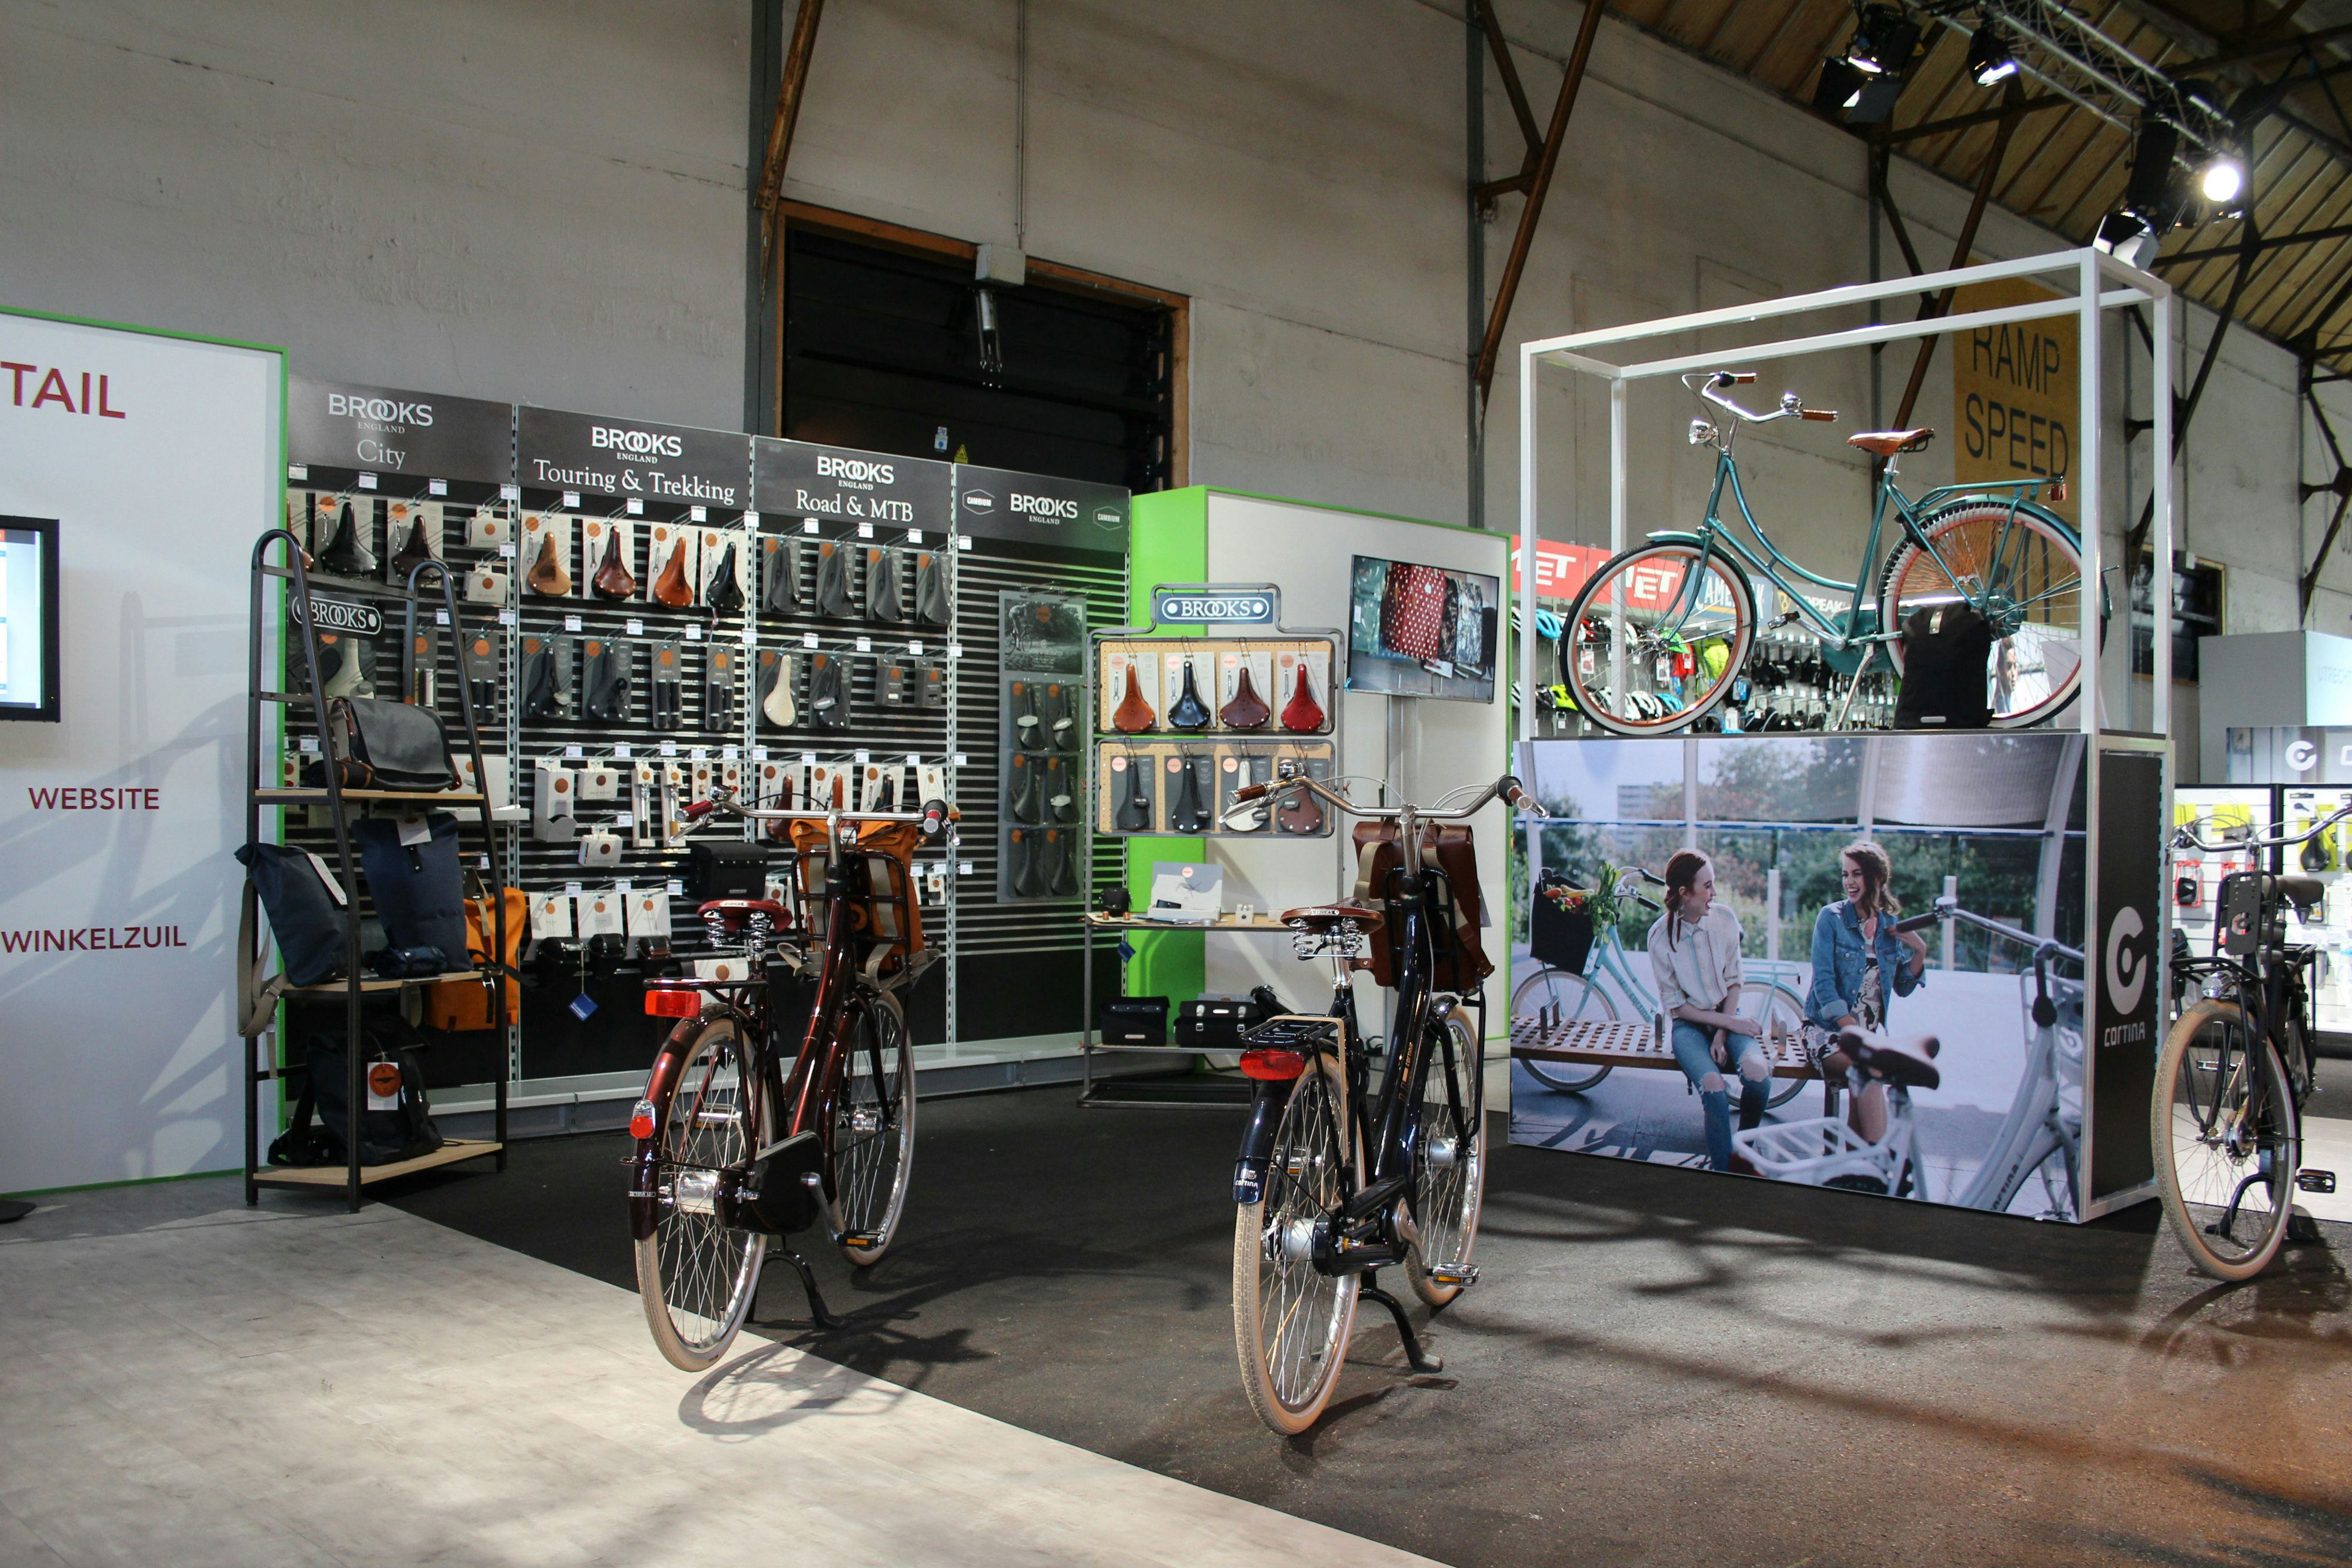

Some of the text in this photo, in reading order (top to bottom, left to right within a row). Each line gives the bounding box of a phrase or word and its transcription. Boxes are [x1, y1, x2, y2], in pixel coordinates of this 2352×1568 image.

[1973, 320, 2060, 396] RAMP
[0, 360, 126, 419] TAIL
[328, 393, 433, 427] BROOKS
[358, 422, 405, 434] ENGLAND
[591, 426, 683, 457] BROOKS
[1965, 392, 2069, 477] SPEED
[357, 439, 406, 470] City
[617, 452, 658, 464] ENGLAND
[533, 459, 735, 506] Touring & Trekking
[817, 456, 895, 485] BROOKS
[838, 480, 874, 491] ENGLAND
[796, 489, 914, 523] Road & MTB
[967, 496, 992, 507] CAMBIUM
[1010, 493, 1078, 519] BROOKS
[1029, 515, 1060, 525] ENGLAND
[310, 601, 367, 629] BROOKS
[1181, 601, 1250, 617] BROOKS
[28, 787, 160, 810] WEBSITE
[1, 925, 187, 953] WINKELZUIL
